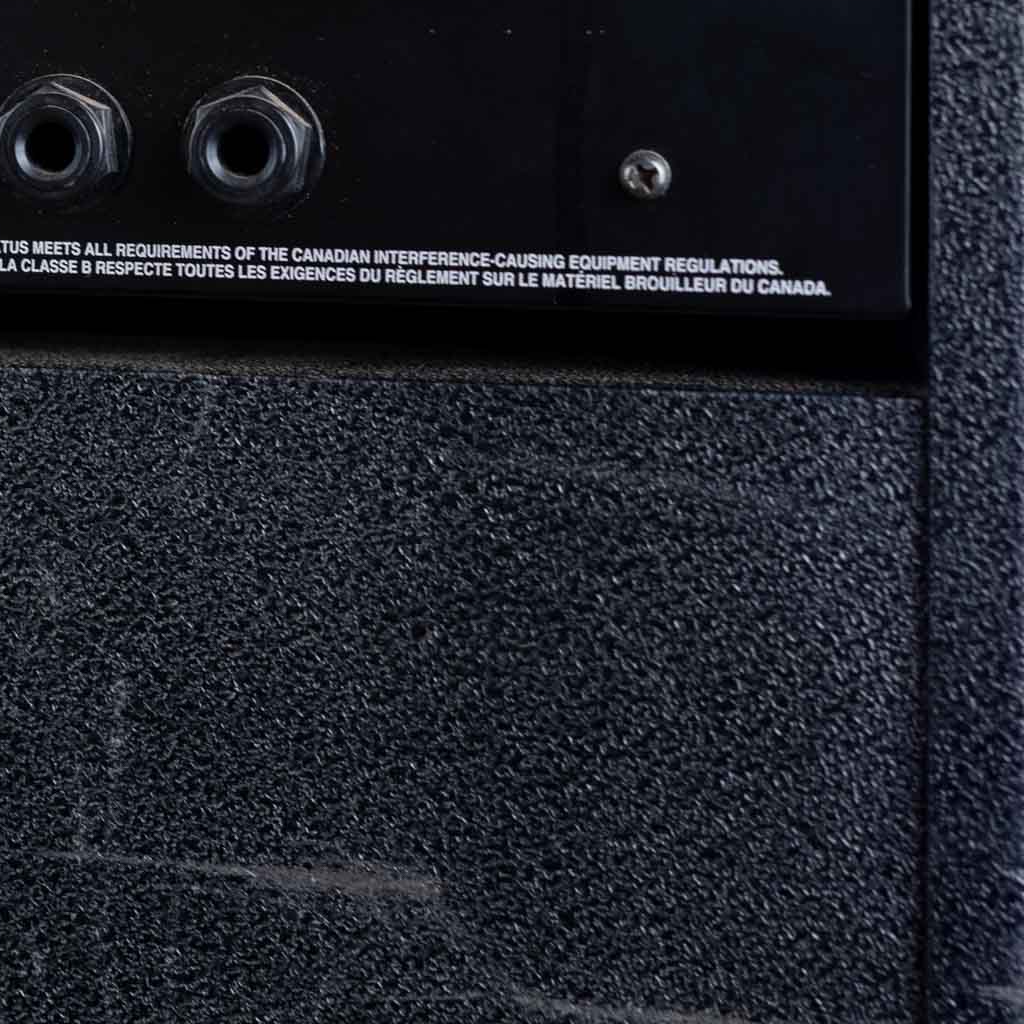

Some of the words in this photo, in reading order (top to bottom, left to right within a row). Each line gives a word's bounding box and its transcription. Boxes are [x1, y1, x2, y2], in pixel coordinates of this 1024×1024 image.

[32, 240, 81, 255] MEETS
[84, 242, 112, 256] ALL
[116, 243, 231, 259] REQUIREMENTS
[234, 246, 255, 260] OF
[259, 246, 289, 261] THE
[292, 247, 370, 263] CANADIAN
[374, 249, 566, 269] INTERFERENCE-CAUSING
[569, 254, 661, 271] EQUIPMENT
[665, 257, 784, 275] REGULATIONS.
[20, 259, 78, 274] CLASSE
[81, 260, 92, 274] B
[95, 261, 172, 277] RESPECTE
[175, 263, 235, 278] TOUTES
[238, 265, 267, 279] LES
[270, 266, 356, 282] EXIGENCES
[359, 268, 381, 282] DU
[385, 266, 480, 285] RÈGLEMENT
[482, 271, 514, 286] SUR
[519, 272, 539, 287] LE
[542, 270, 620, 289] MATÉRIEL
[624, 275, 726, 292] BROUILLEUR
[730, 278, 753, 293] DU
[757, 279, 832, 295] CANADA.
